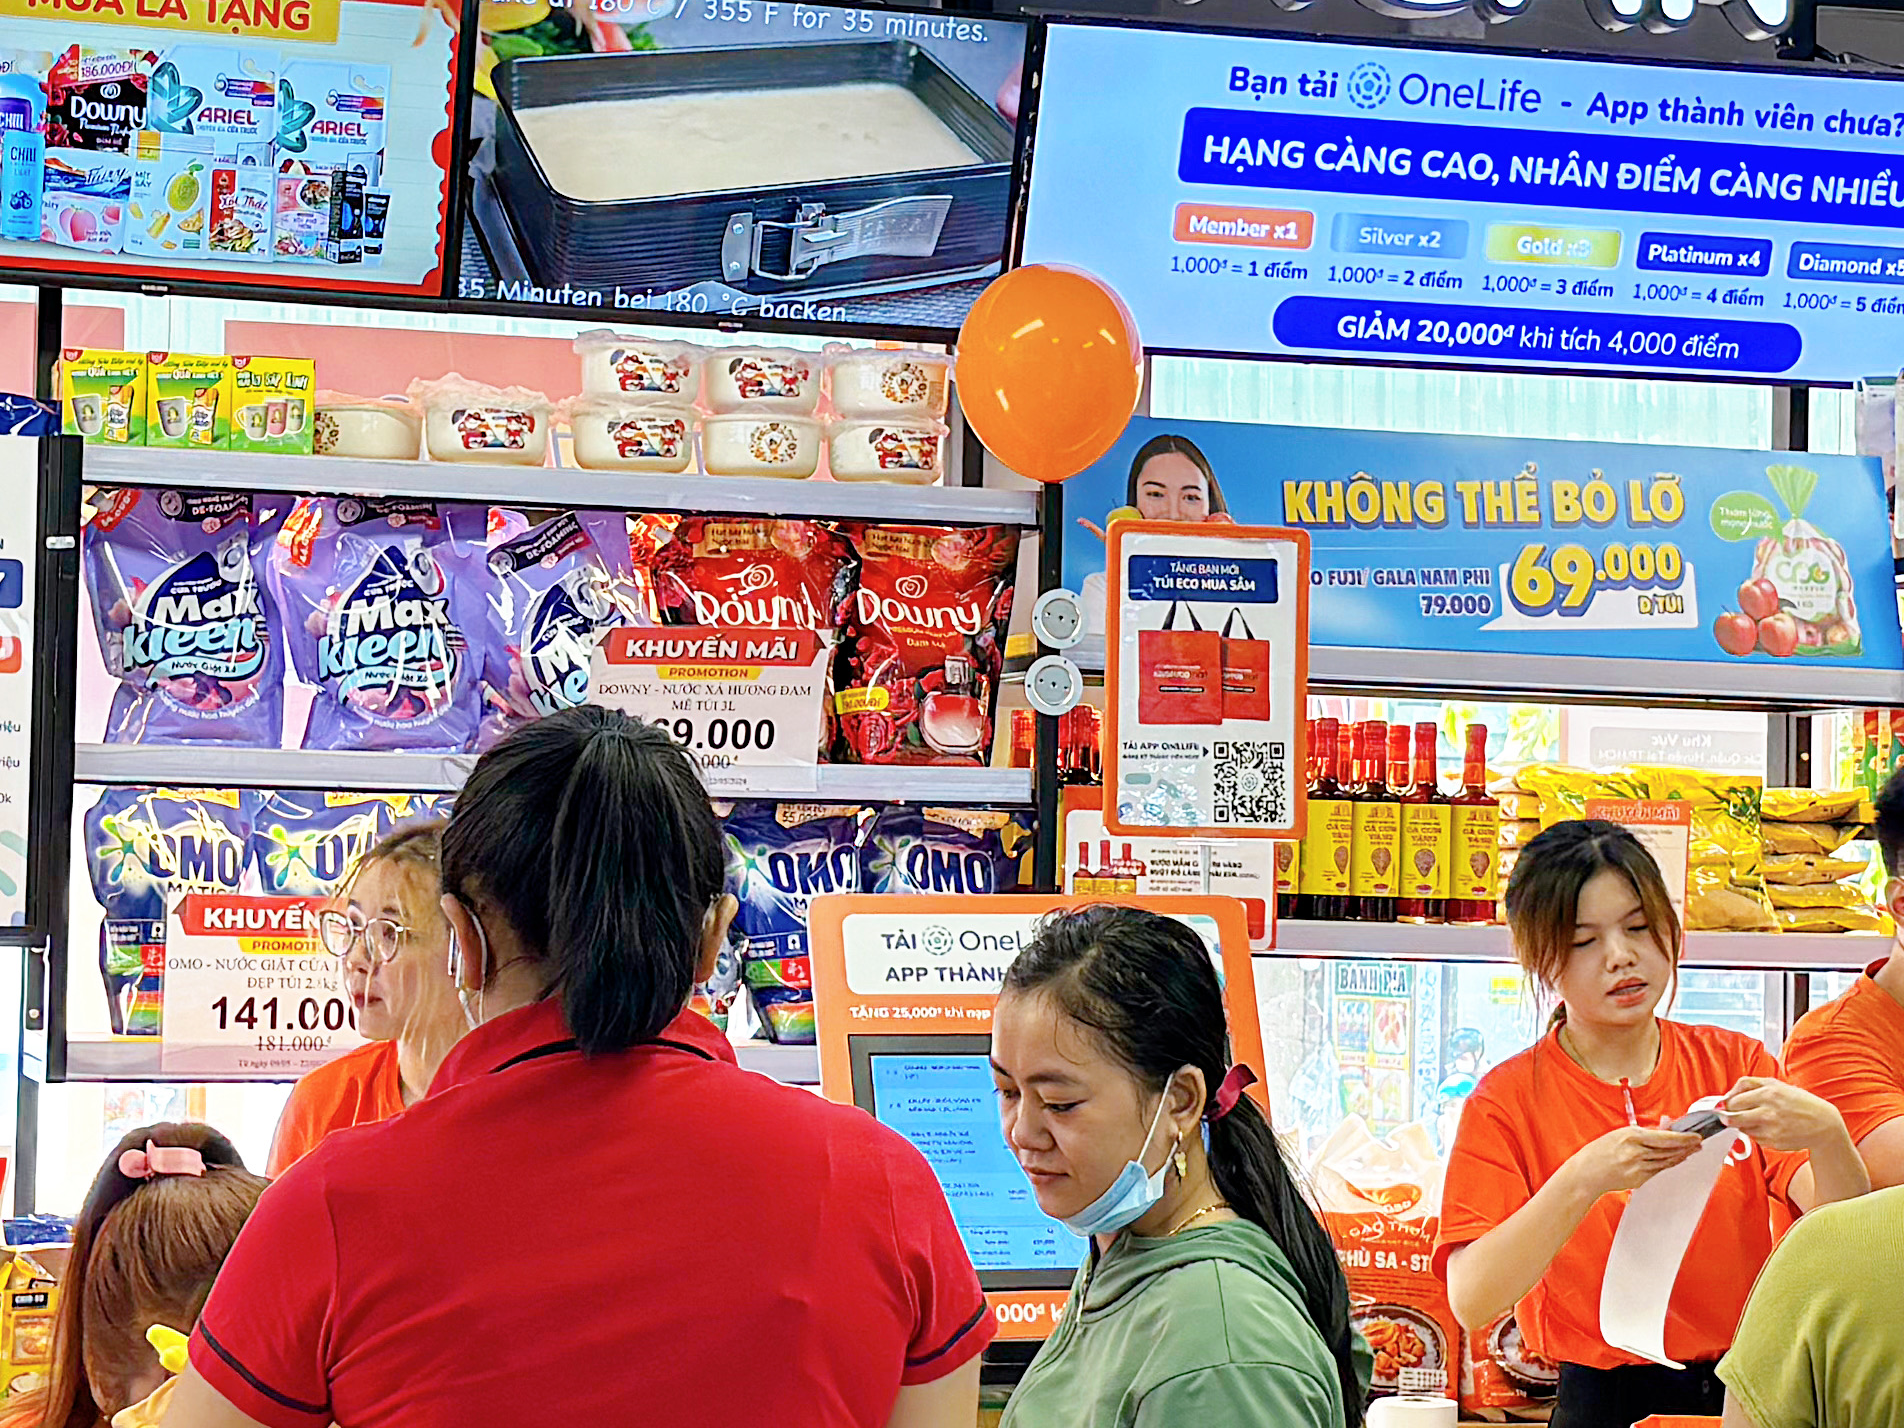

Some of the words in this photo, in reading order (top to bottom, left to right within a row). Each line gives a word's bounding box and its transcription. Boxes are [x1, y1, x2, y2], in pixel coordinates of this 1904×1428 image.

[765, 3, 780, 25] F
[793, 6, 826, 30] for
[843, 11, 874, 33] 35
[885, 15, 989, 42] minutes.
[1228, 66, 1287, 101] Bạn
[1298, 70, 1338, 98] tải
[1398, 73, 1542, 113] OneLife
[1587, 92, 1649, 125] App
[1658, 97, 1745, 127] thành
[1754, 102, 1814, 132] viên
[70, 96, 147, 130] Downy
[197, 107, 260, 126] ARIEL
[1203, 134, 1305, 173] HẠNG
[1314, 135, 1412, 175] CÀNG
[1421, 151, 1500, 186] CAO,
[1508, 150, 1609, 190] NHÂN
[1616, 154, 1701, 194] ĐIỂM
[1709, 162, 1802, 201] CÀNG
[1188, 216, 1270, 238] Member
[1274, 222, 1298, 241] x1
[1359, 227, 1413, 247] Silver
[1419, 231, 1441, 248] x2
[1517, 236, 1562, 258] Gold
[1648, 243, 1733, 267] Platinum
[1737, 250, 1761, 268] x4
[1798, 253, 1882, 276] Diamond
[497, 281, 602, 309] Minuten
[614, 287, 654, 311] bei
[664, 292, 708, 315] 180
[1337, 310, 1410, 341] GIẢM
[1519, 324, 1553, 350] khi
[1560, 329, 1605, 351] tích
[1608, 330, 1677, 357] 4,000
[1682, 332, 1740, 360] điểm
[1283, 471, 1446, 525] KHÔNG
[1456, 462, 1541, 525] THỂ
[1552, 467, 1617, 525] BỎ
[1629, 472, 1685, 525] LỠ
[1153, 576, 1173, 589] TÚI
[1176, 578, 1198, 589] ECO
[1201, 579, 1227, 590] MUA
[1230, 577, 1256, 591] SẮM
[1373, 569, 1417, 587] GALA
[1421, 569, 1457, 586] NAM
[1463, 569, 1491, 586] PHI
[1511, 544, 1683, 608] 69.000
[348, 595, 448, 636] Max
[857, 588, 981, 635] Downy
[1421, 595, 1492, 615] 79.000
[123, 618, 257, 670] kleen
[626, 633, 738, 659] KHUYẾN
[746, 637, 798, 659] MÃI
[669, 667, 748, 678] PROMOTION
[599, 684, 651, 696] DOWNY
[663, 683, 700, 696] NƯỚC
[729, 684, 777, 696] HƯƠNG
[672, 699, 692, 711] MÊ
[696, 698, 718, 712] TÚI
[721, 700, 735, 712] 3L
[768, 844, 860, 895] OMO
[169, 958, 203, 970] OMO
[216, 958, 257, 971] NƯỚC
[261, 958, 294, 972] GIẶT
